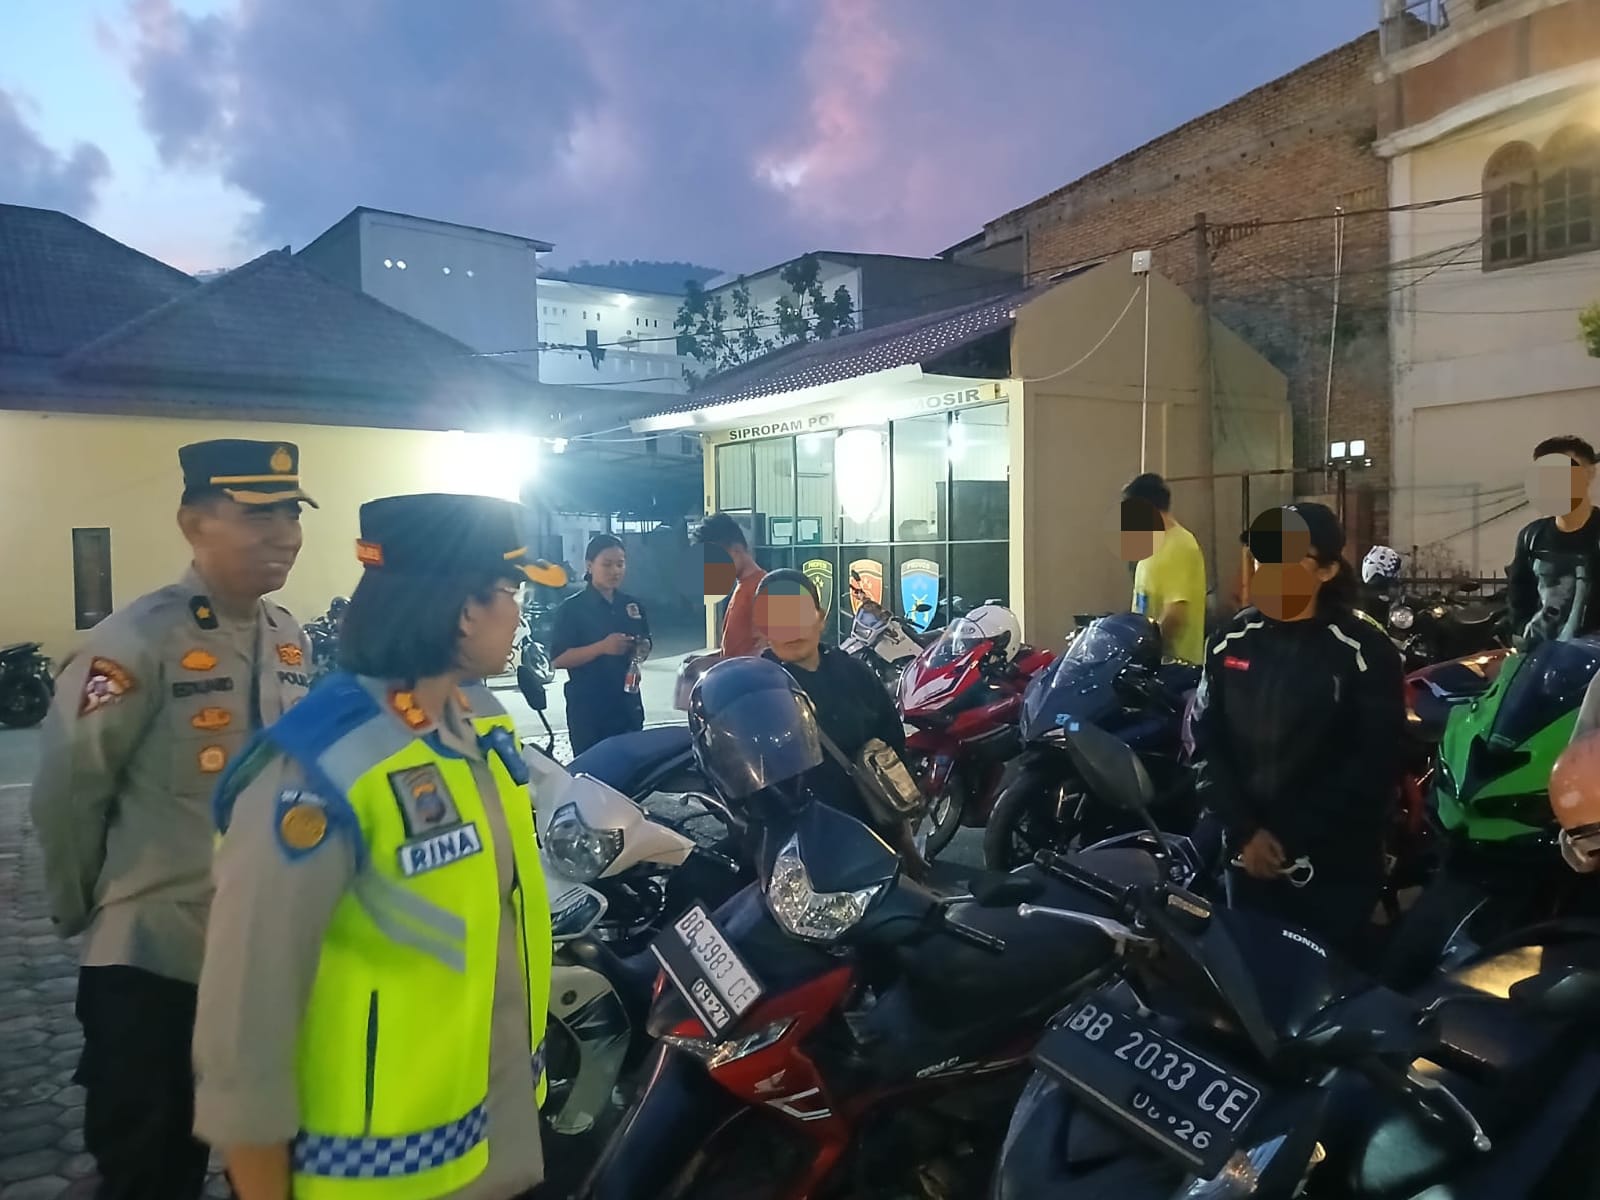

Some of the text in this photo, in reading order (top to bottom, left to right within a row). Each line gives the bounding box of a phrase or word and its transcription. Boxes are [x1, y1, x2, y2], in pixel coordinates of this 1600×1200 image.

[729, 420, 802, 440] SIPROPAM
[912, 389, 980, 410] MOSIR
[410, 831, 475, 872] RINA
[696, 935, 735, 980] 3983
[1281, 929, 1328, 958] HONDA
[1069, 1003, 1249, 1125] BB 2033 CE
